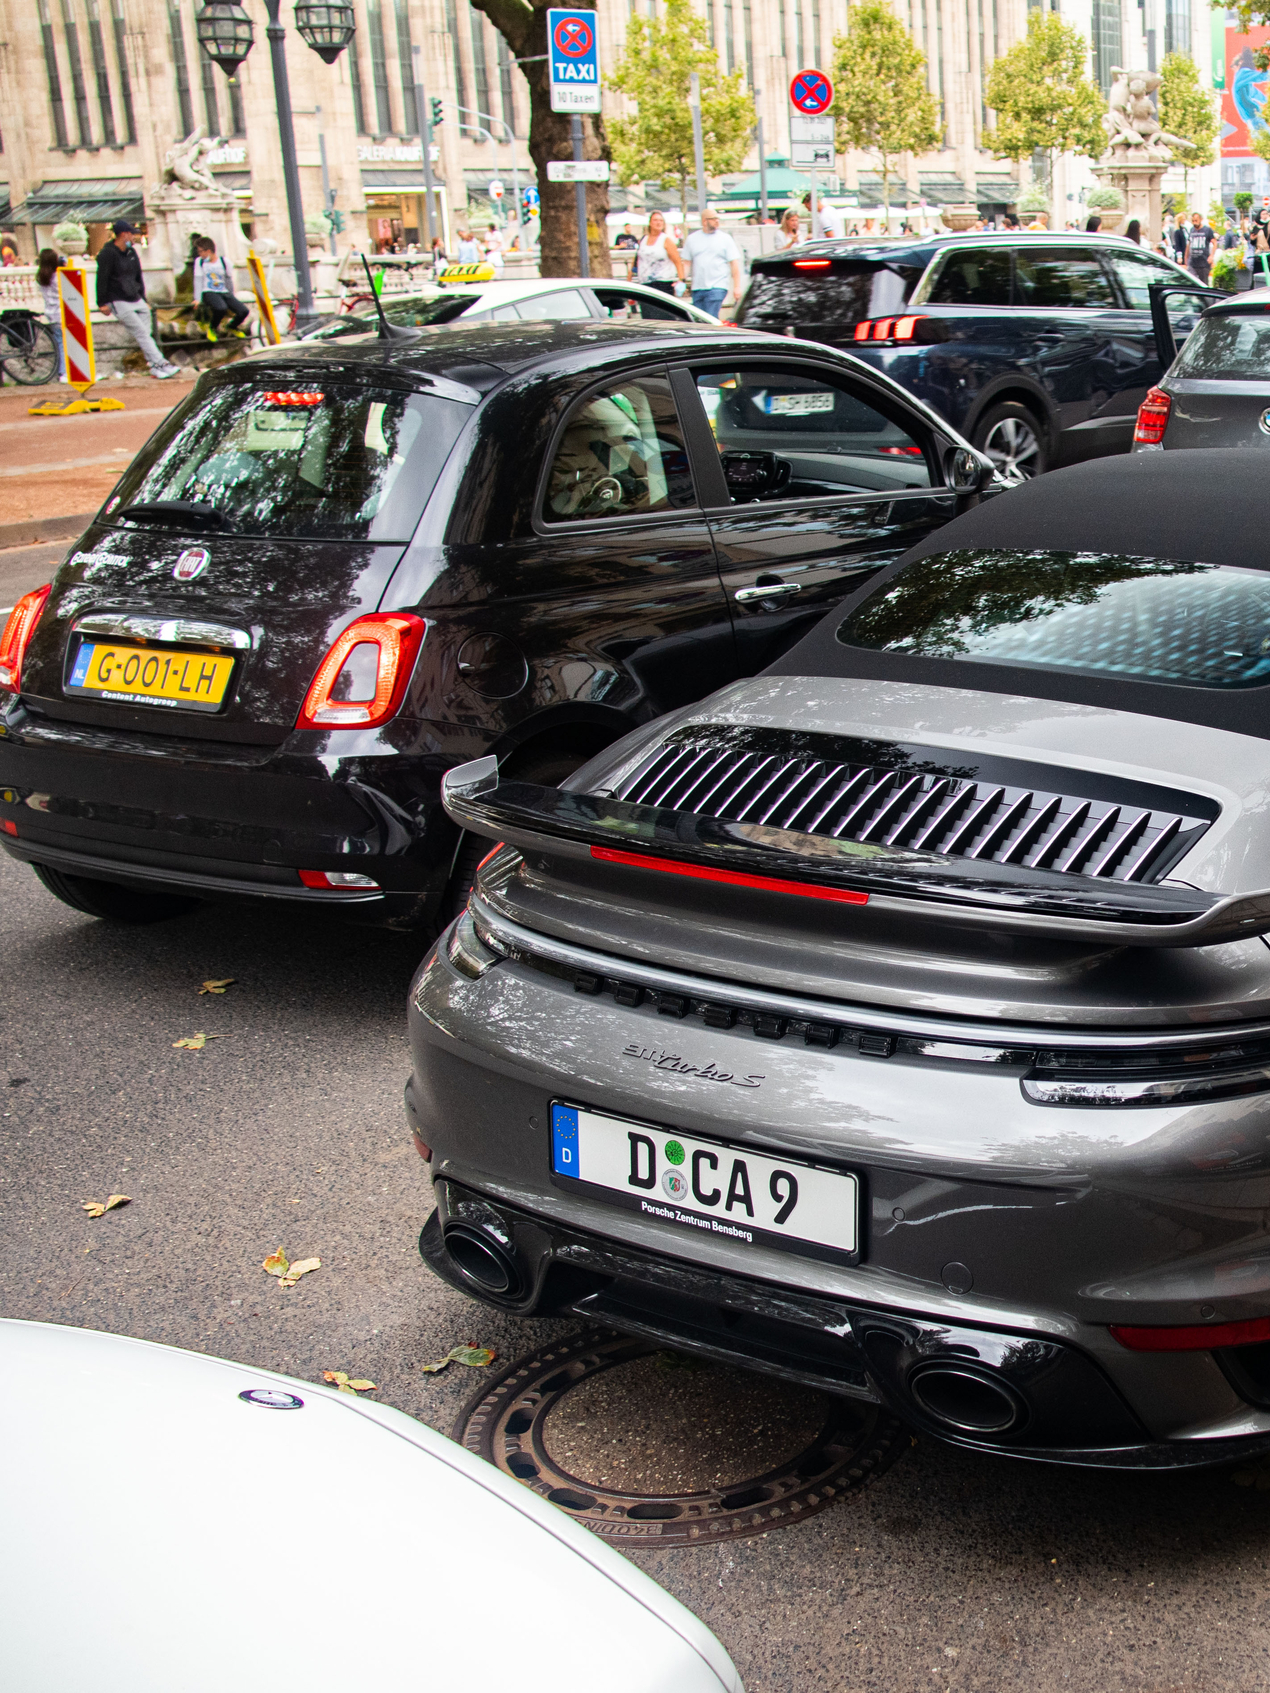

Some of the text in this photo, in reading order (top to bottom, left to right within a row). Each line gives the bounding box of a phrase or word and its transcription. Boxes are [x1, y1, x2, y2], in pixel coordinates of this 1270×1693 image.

[554, 63, 595, 81] TAXI
[557, 91, 595, 104] 10 Taxen
[180, 556, 203, 572] FIAT
[74, 651, 218, 695] NL G-001-LH
[101, 690, 178, 708] Content Autogroep
[653, 1055, 734, 1082] turbo
[731, 1073, 766, 1088] S
[562, 1147, 572, 1163] D
[627, 1131, 656, 1190] D
[691, 1149, 754, 1218] CA
[769, 1169, 798, 1225] 9
[641, 1201, 753, 1242] Porsche Zentrum Bensberg
